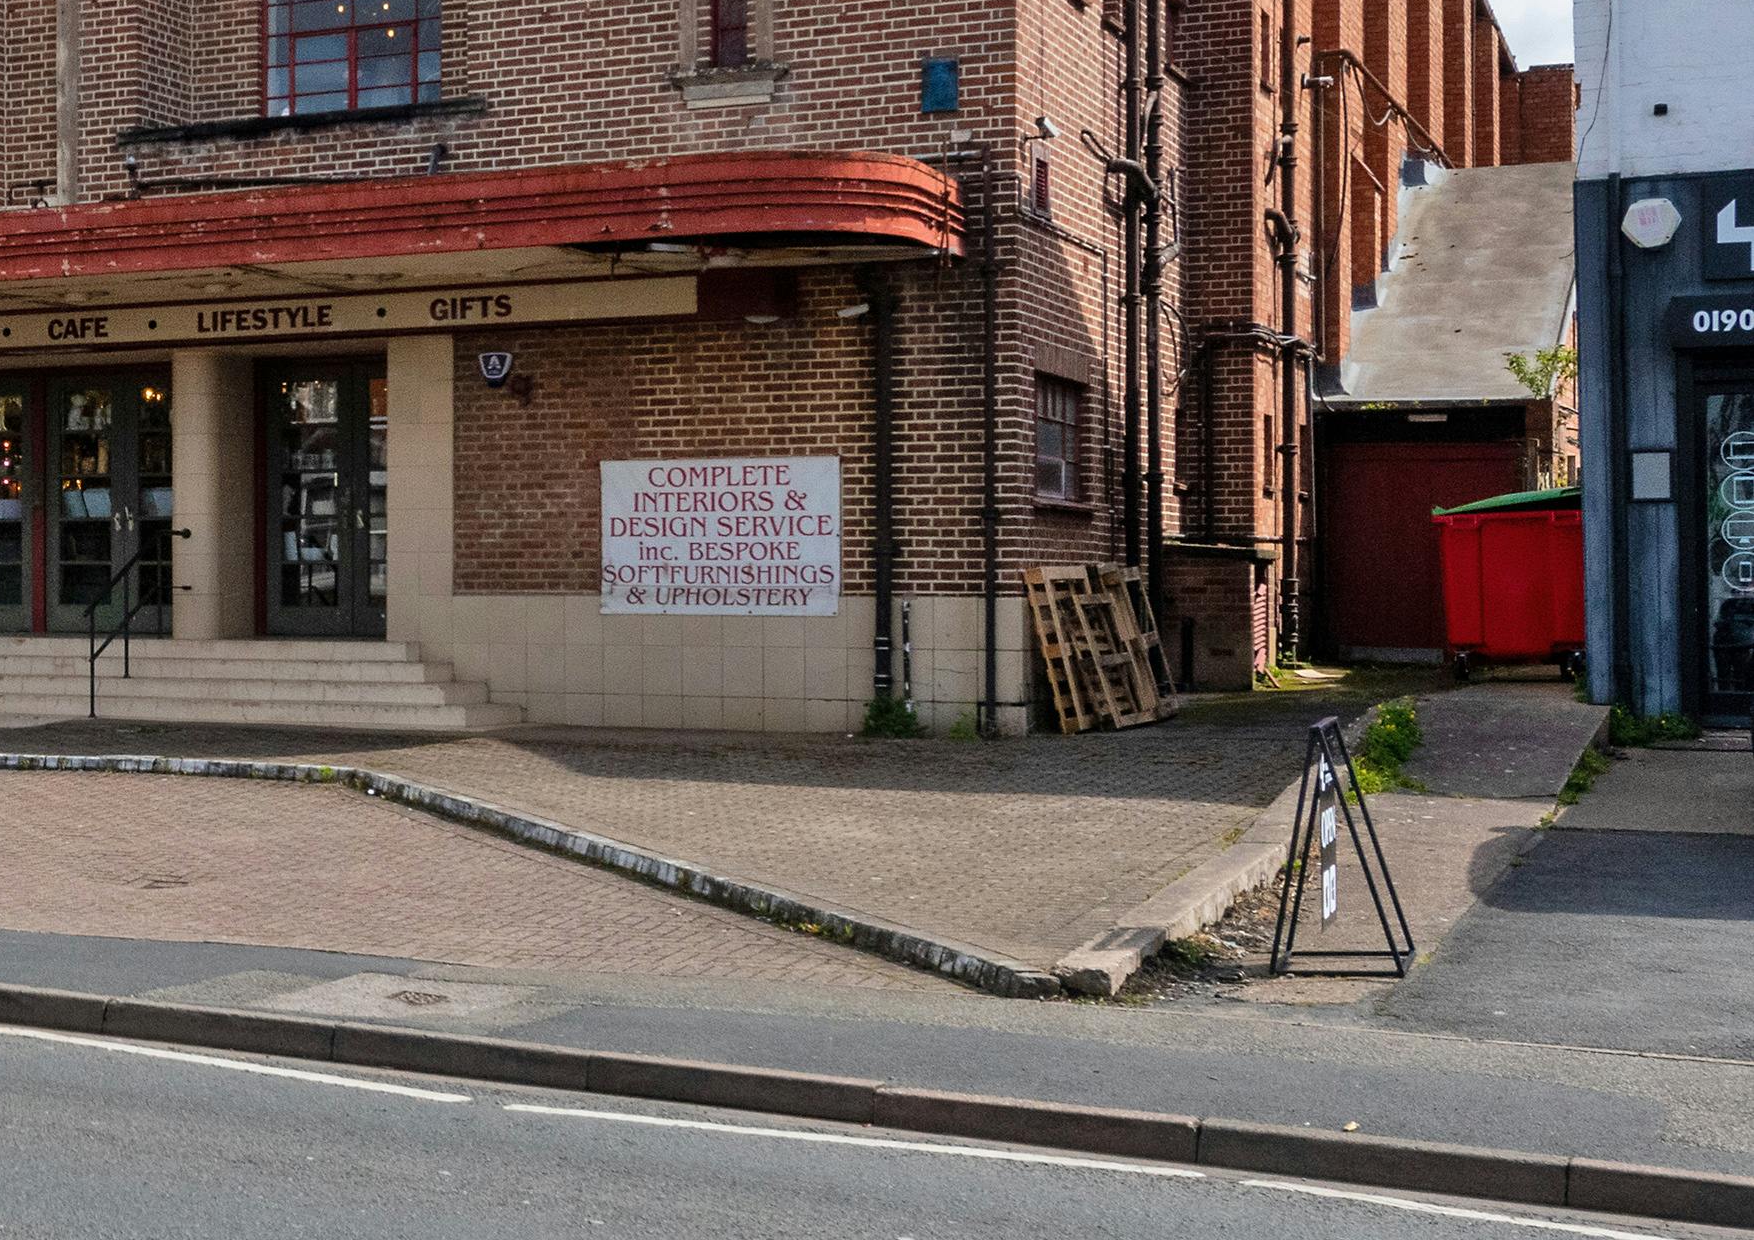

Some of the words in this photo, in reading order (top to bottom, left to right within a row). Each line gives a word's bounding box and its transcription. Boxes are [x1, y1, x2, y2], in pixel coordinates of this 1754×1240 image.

[47, 317, 109, 340] CAFE
[197, 304, 333, 333] LIFESTYLE
[429, 294, 513, 321] GIFTS
[648, 465, 791, 488] COMPLETE
[633, 490, 774, 513] INTERIORS
[784, 489, 807, 511] &
[609, 516, 707, 537] DESIGN
[716, 515, 834, 537] SERVICE
[639, 541, 678, 561] inc.
[689, 541, 801, 561] BESPOKE
[626, 587, 646, 605] &
[656, 587, 813, 606] UPHOLSTERY
